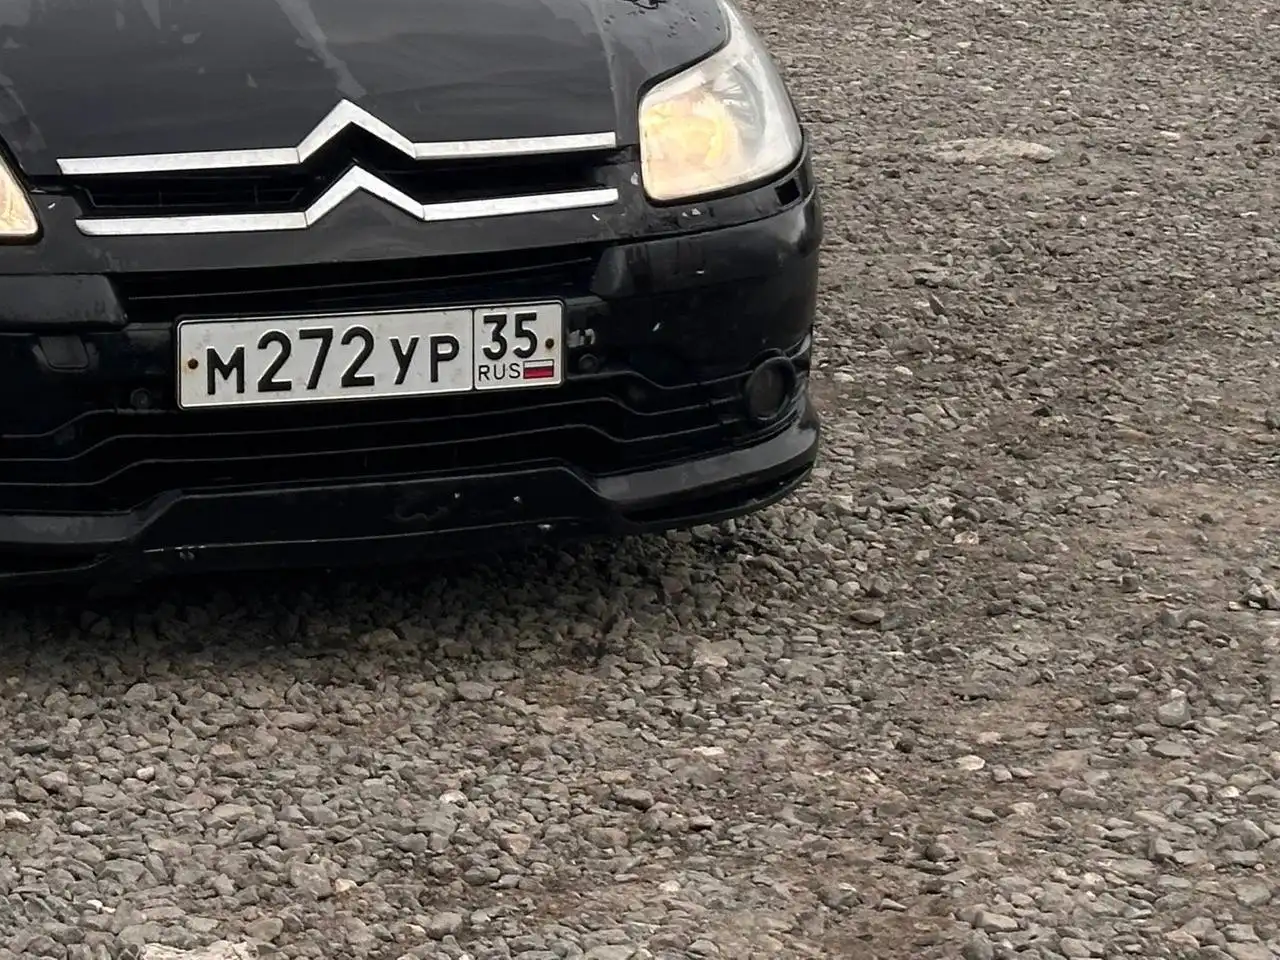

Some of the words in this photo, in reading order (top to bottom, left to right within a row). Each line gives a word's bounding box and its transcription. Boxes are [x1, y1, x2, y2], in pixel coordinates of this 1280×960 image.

[207, 325, 459, 394] М272УР
[482, 313, 538, 360] 35
[479, 361, 521, 381] RUS
